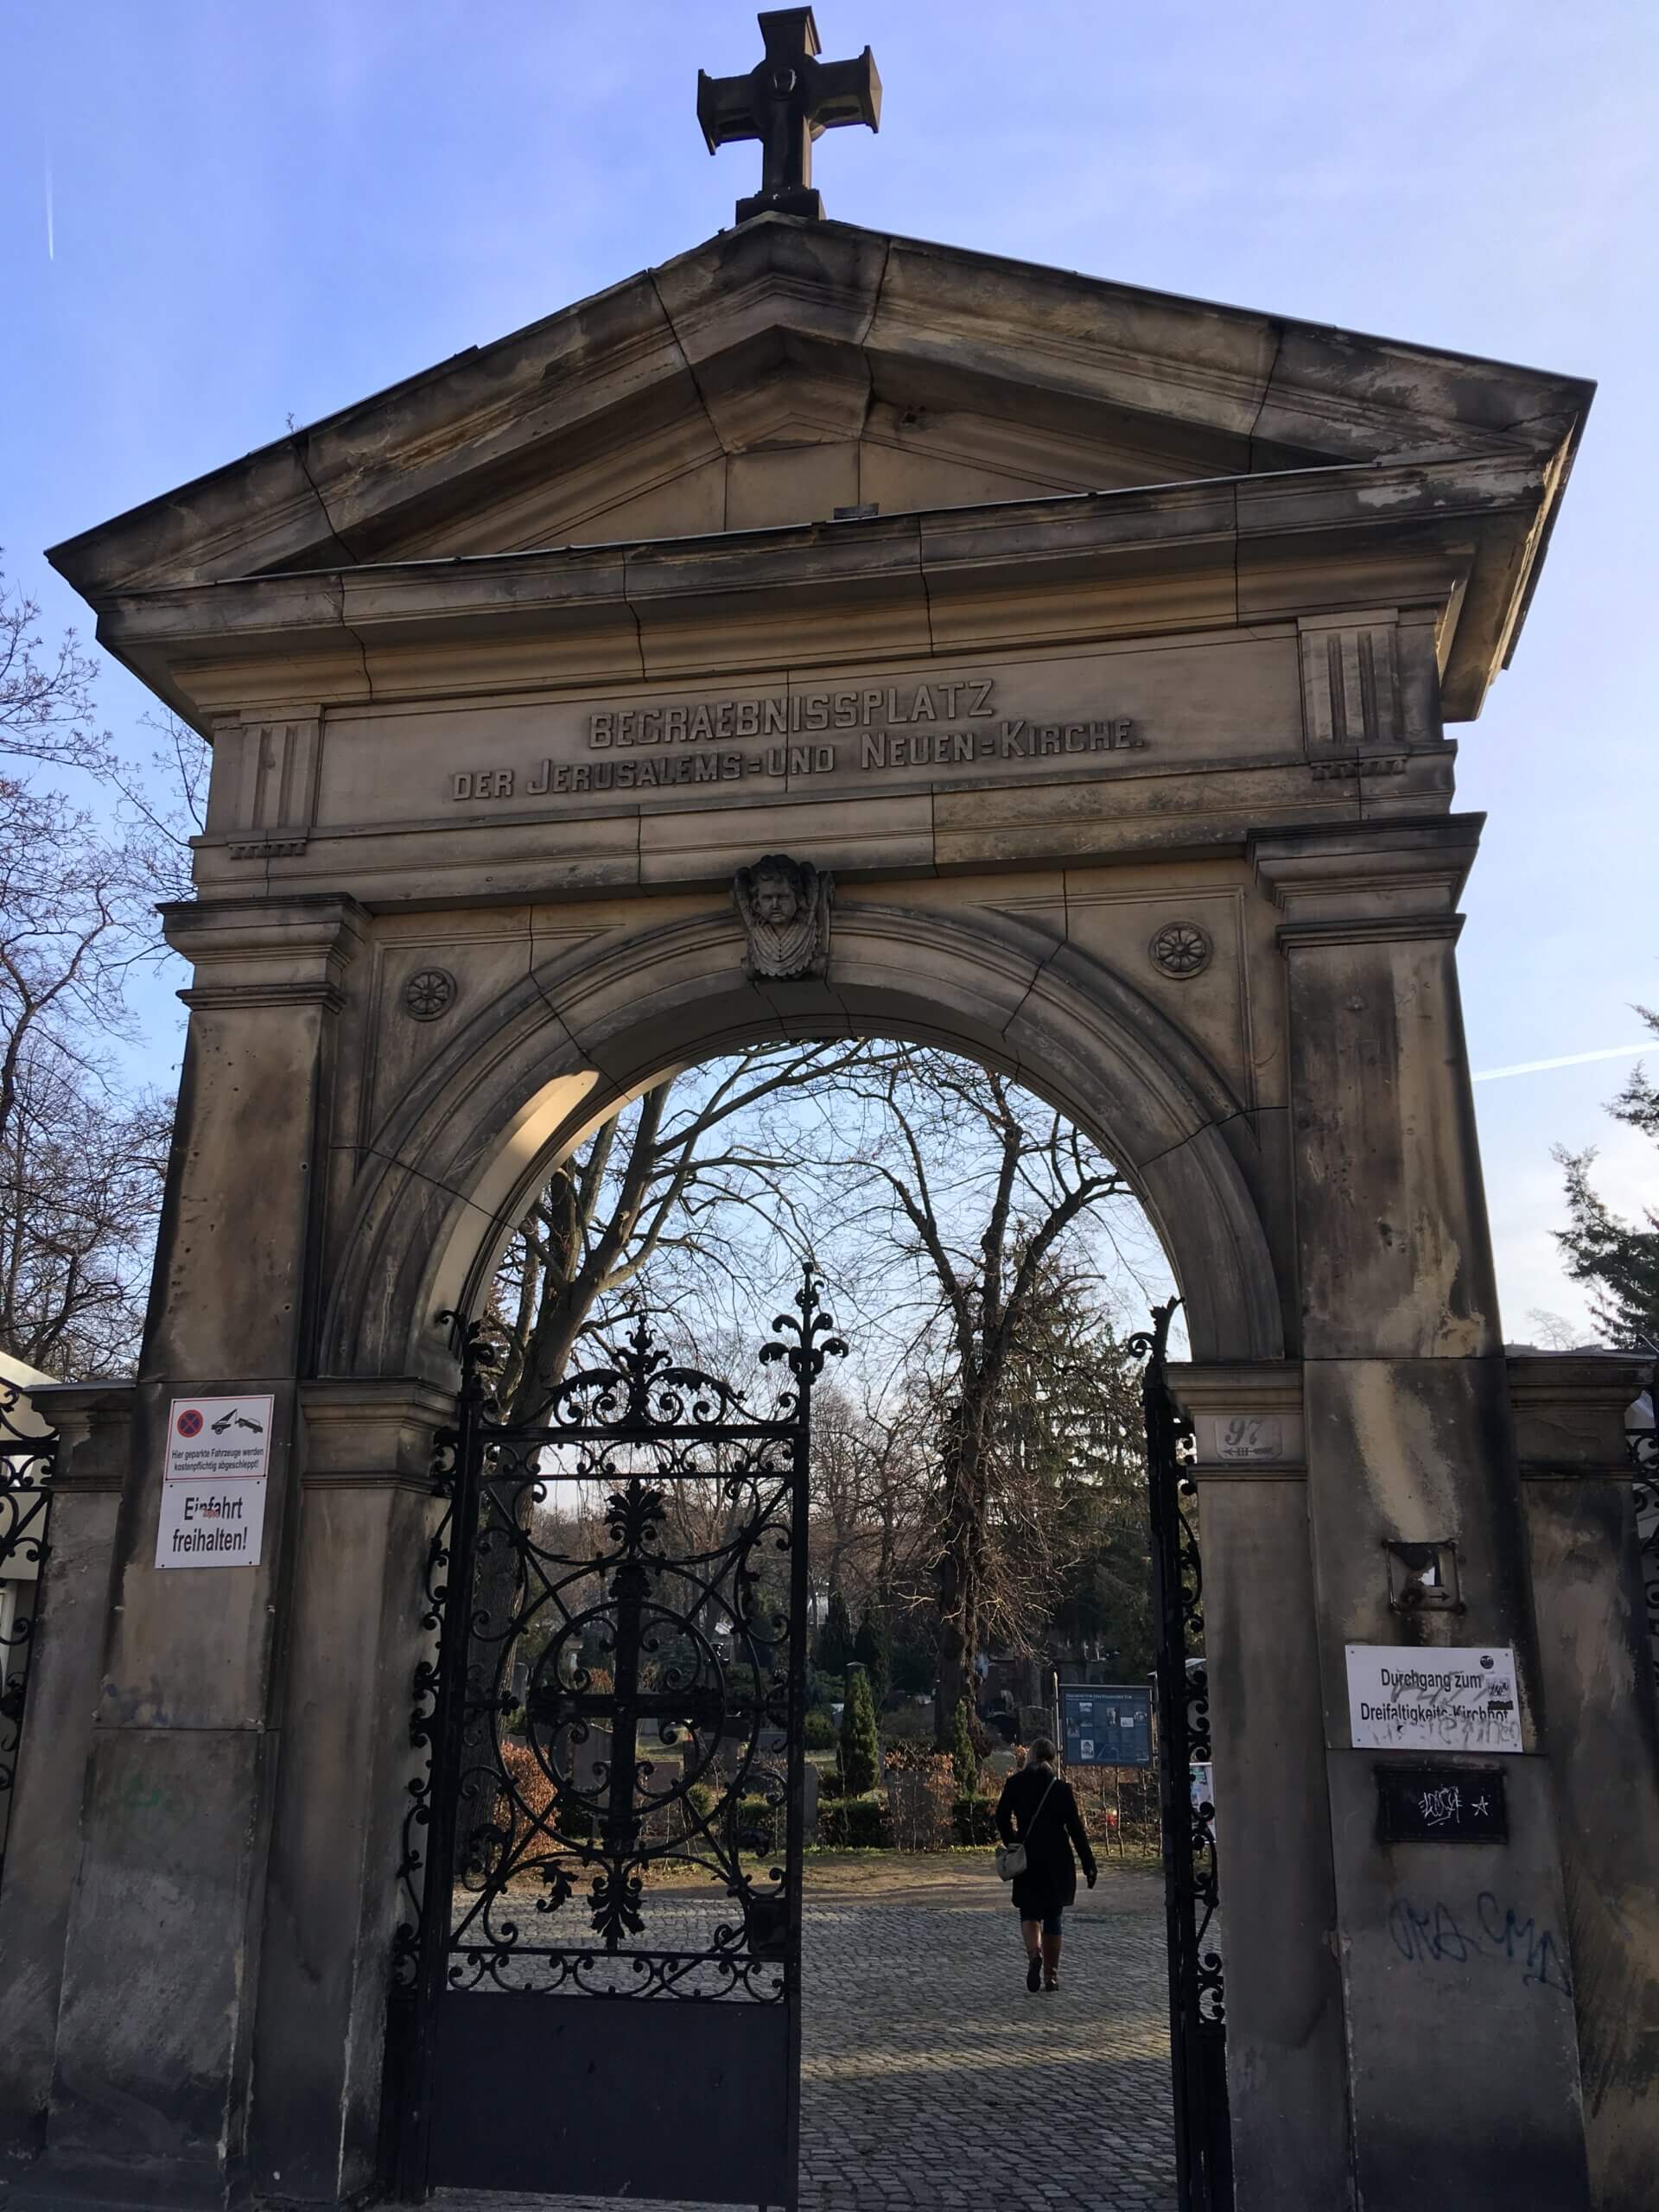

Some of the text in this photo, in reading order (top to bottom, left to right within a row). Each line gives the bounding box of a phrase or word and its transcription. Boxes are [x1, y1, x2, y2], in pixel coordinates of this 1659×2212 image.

[589, 679, 994, 749] BEGRAEBNISSPLATZ
[453, 771, 514, 801] DER
[1224, 1416, 1263, 1446] 97
[172, 1447, 264, 1460] Hier geparkte Fahrzeuge werden
[174, 1459, 259, 1472] kostenpflichtig abgeschleppt!
[184, 1497, 243, 1521] Einfahrt
[173, 1527, 248, 1553] freihalten!
[1381, 1669, 1452, 1692] Durchgang
[1455, 1673, 1481, 1688] zum
